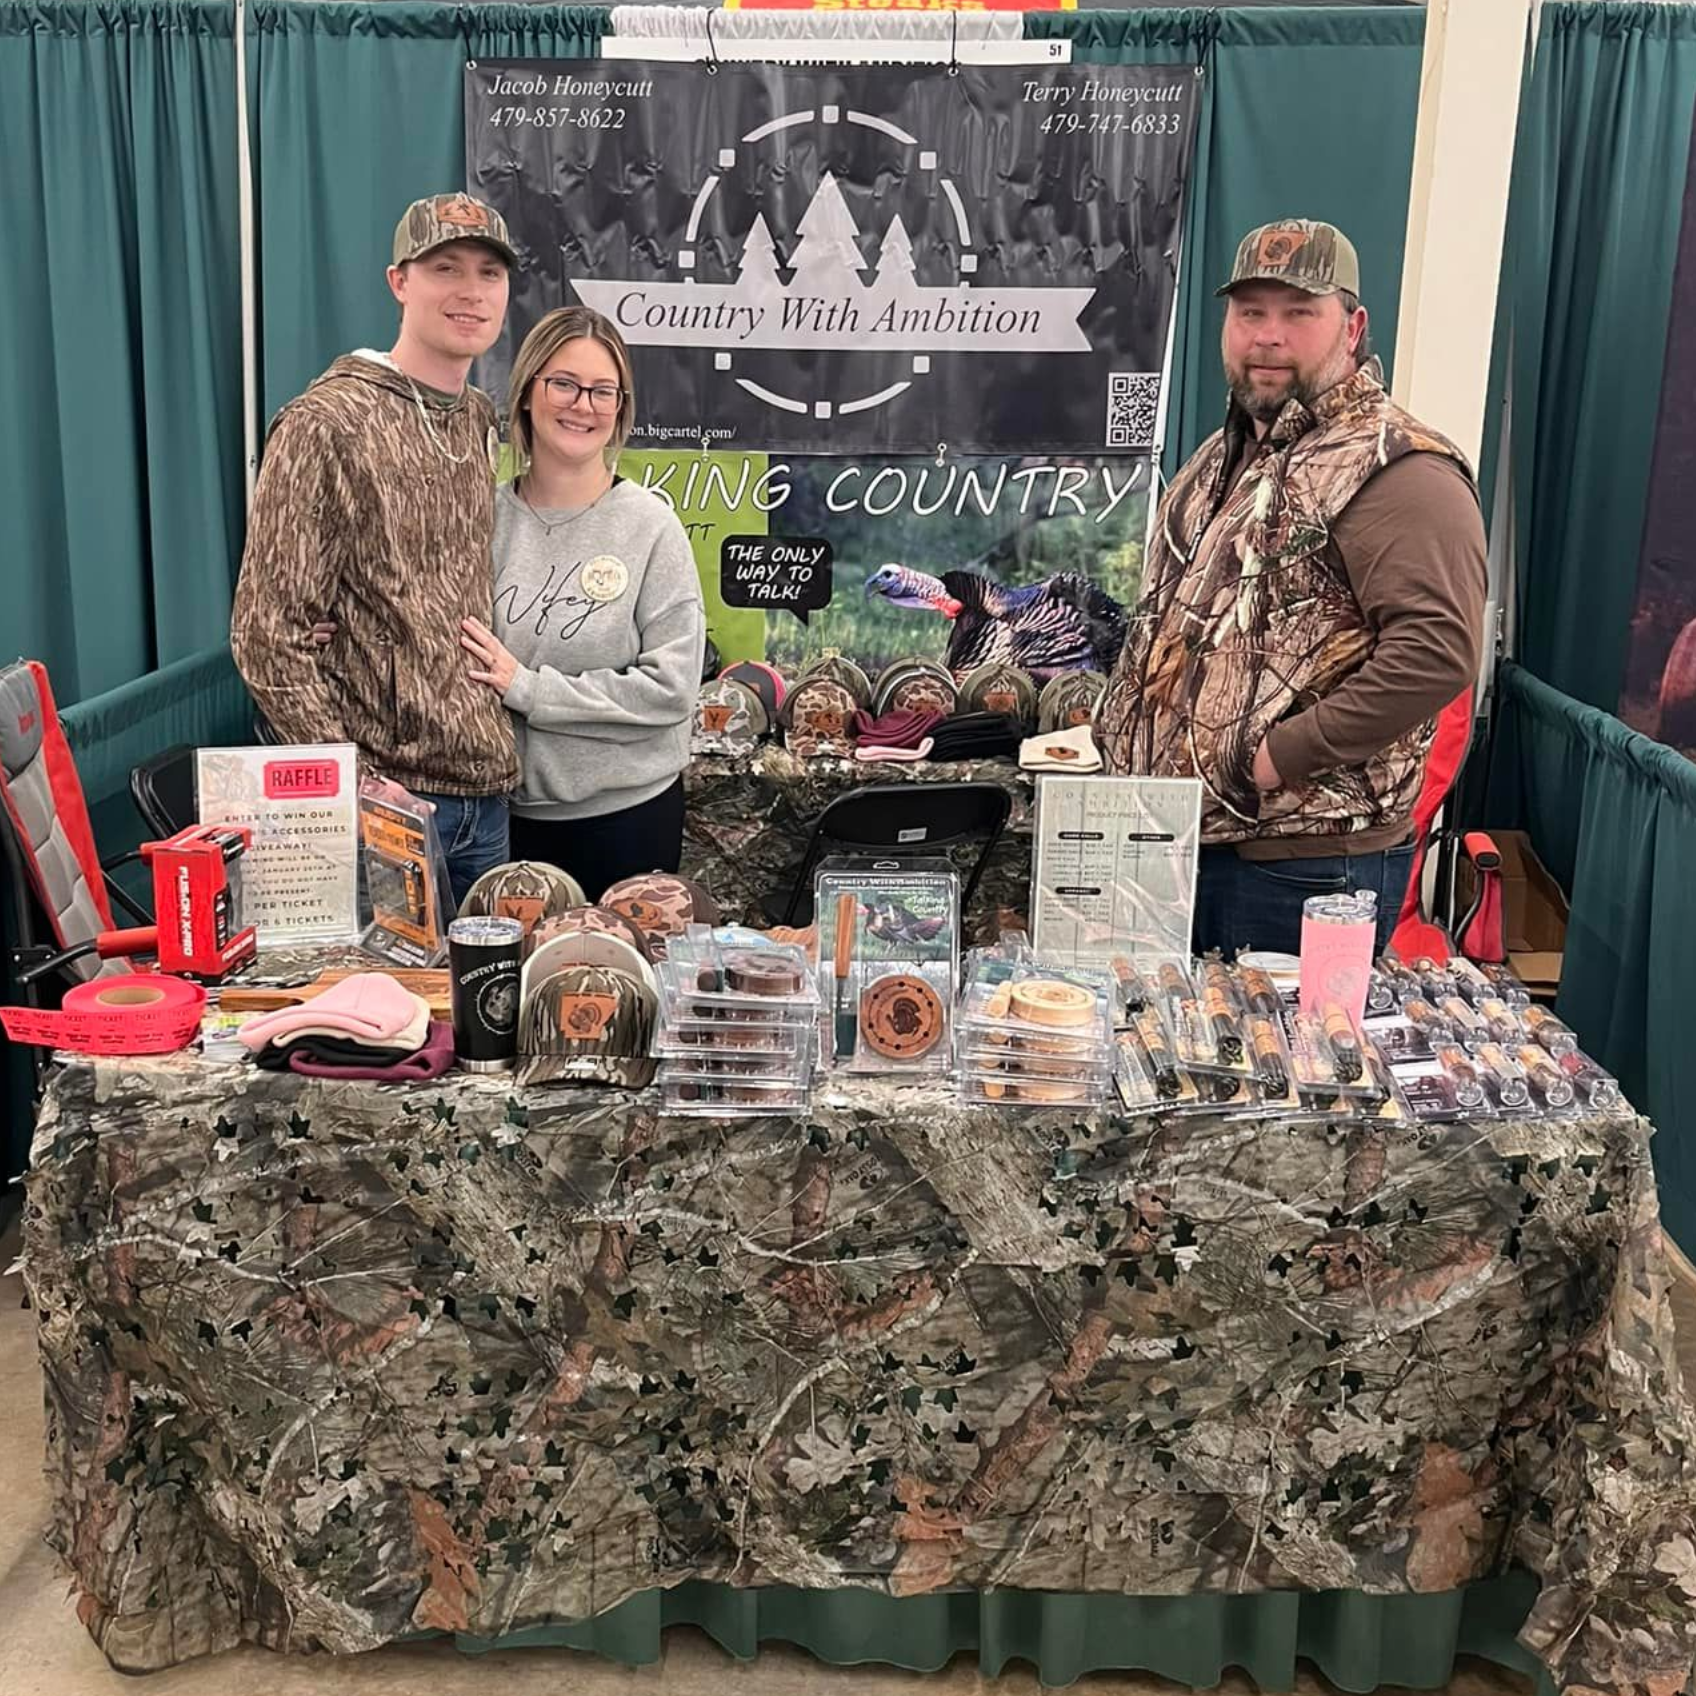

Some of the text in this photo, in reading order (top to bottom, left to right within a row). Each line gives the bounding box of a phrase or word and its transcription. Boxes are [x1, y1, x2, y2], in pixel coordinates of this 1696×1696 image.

[1049, 44, 1062, 57] 51
[487, 74, 653, 101] Jacob Honeycutt
[1022, 81, 1182, 109] Terry Honeycutt
[490, 106, 626, 129] 479-857-8622
[1040, 113, 1180, 136] 479-747-6833
[616, 291, 1041, 339] Country With Ambition
[629, 424, 737, 440] on.bigcartel.com/
[641, 456, 1142, 522] KING COUNTRY
[727, 544, 826, 565] THE ONLY
[735, 563, 813, 583] WAY TO
[747, 582, 801, 601] TALK!
[272, 768, 333, 787] RAFFLE
[225, 810, 333, 822] ENTER TO WIN OUR
[272, 825, 346, 835] ACCESSORIES
[254, 901, 276, 910] PER
[282, 898, 323, 909] TICKET
[286, 914, 335, 925] TICKETS
